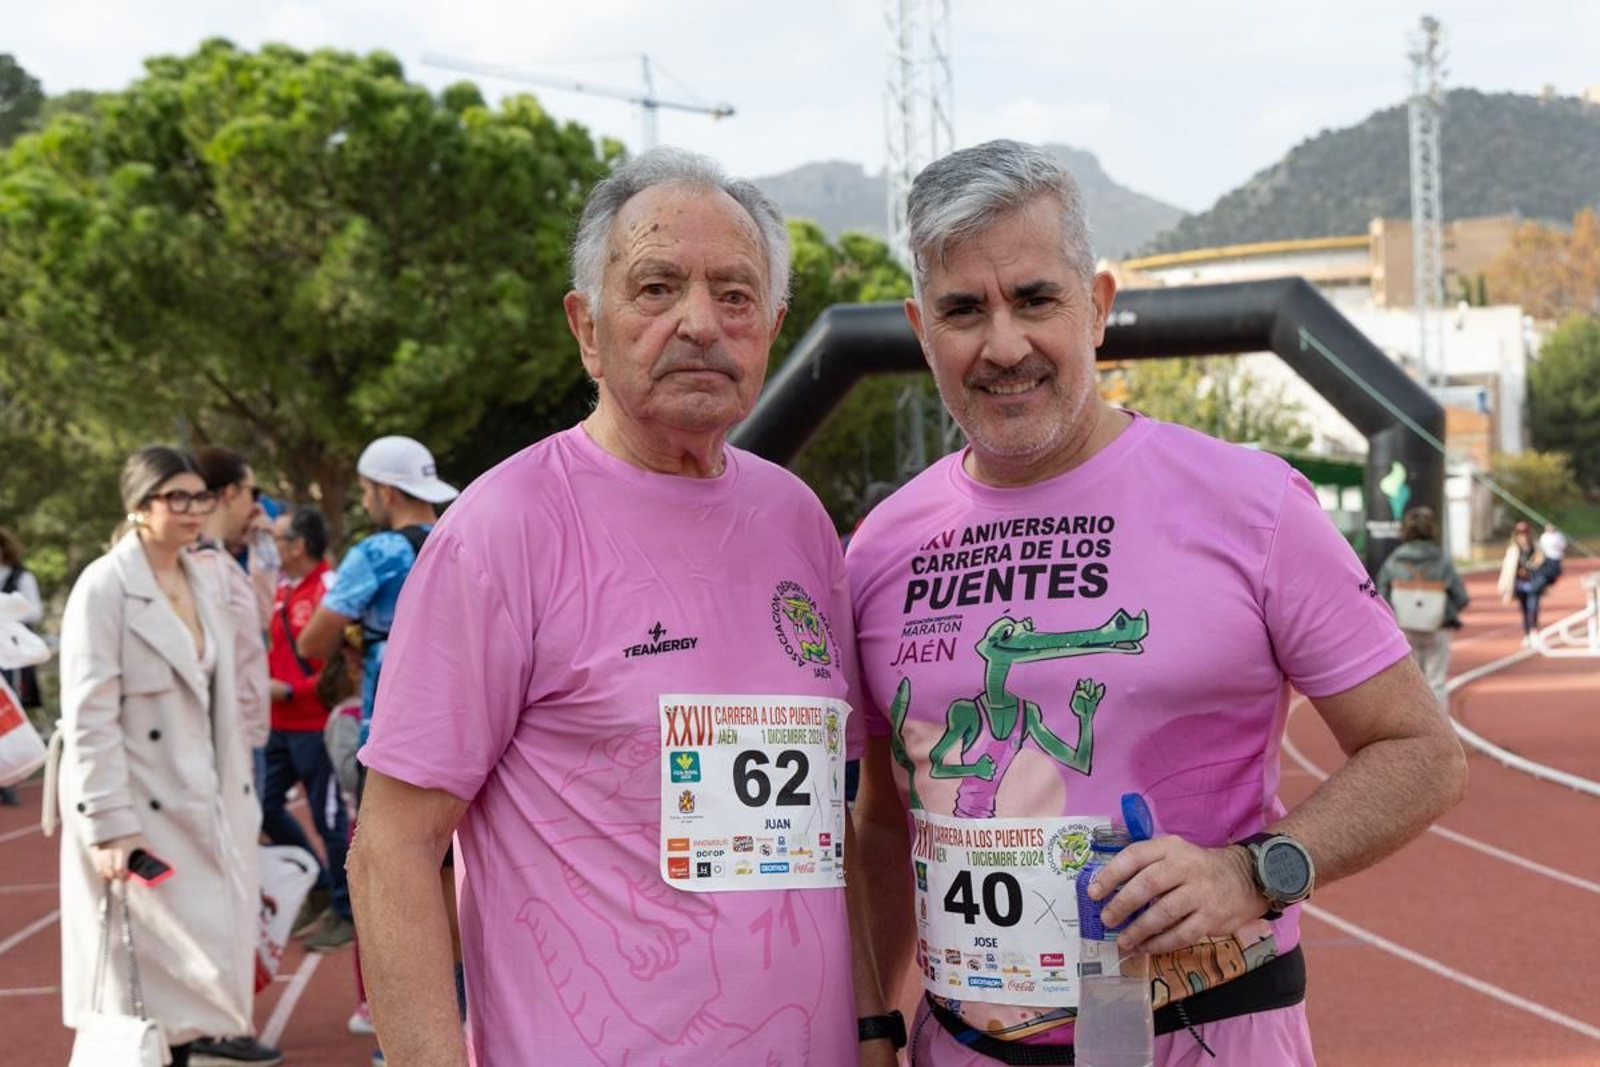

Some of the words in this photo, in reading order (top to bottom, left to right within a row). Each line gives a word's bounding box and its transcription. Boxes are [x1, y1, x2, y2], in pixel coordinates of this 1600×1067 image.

[920, 530, 956, 551] XV
[960, 516, 1115, 547] ANIVERSARIO
[911, 543, 1012, 575] CARRERA
[1020, 540, 1053, 560] DE
[1061, 539, 1112, 558] LOS
[903, 562, 1109, 614] PUENTES
[622, 637, 698, 658] TEAMERGY
[890, 637, 957, 666] JAÉN
[714, 706, 759, 725] CARRERA
[761, 707, 767, 725] A
[769, 707, 787, 725] LOS
[789, 707, 822, 726] PUENTES
[761, 729, 766, 745] 1
[767, 729, 807, 745] DICIEMBRE
[733, 750, 811, 808] 62
[764, 818, 791, 830] JUAN
[966, 830, 973, 848] A
[973, 829, 992, 848] LOS
[995, 828, 1044, 848] PUENTES
[966, 851, 970, 866] 1
[971, 851, 1020, 867] DICIEMBRE
[1021, 851, 1044, 867] 2024
[944, 870, 1023, 927] 40
[974, 937, 998, 948] JOSE
